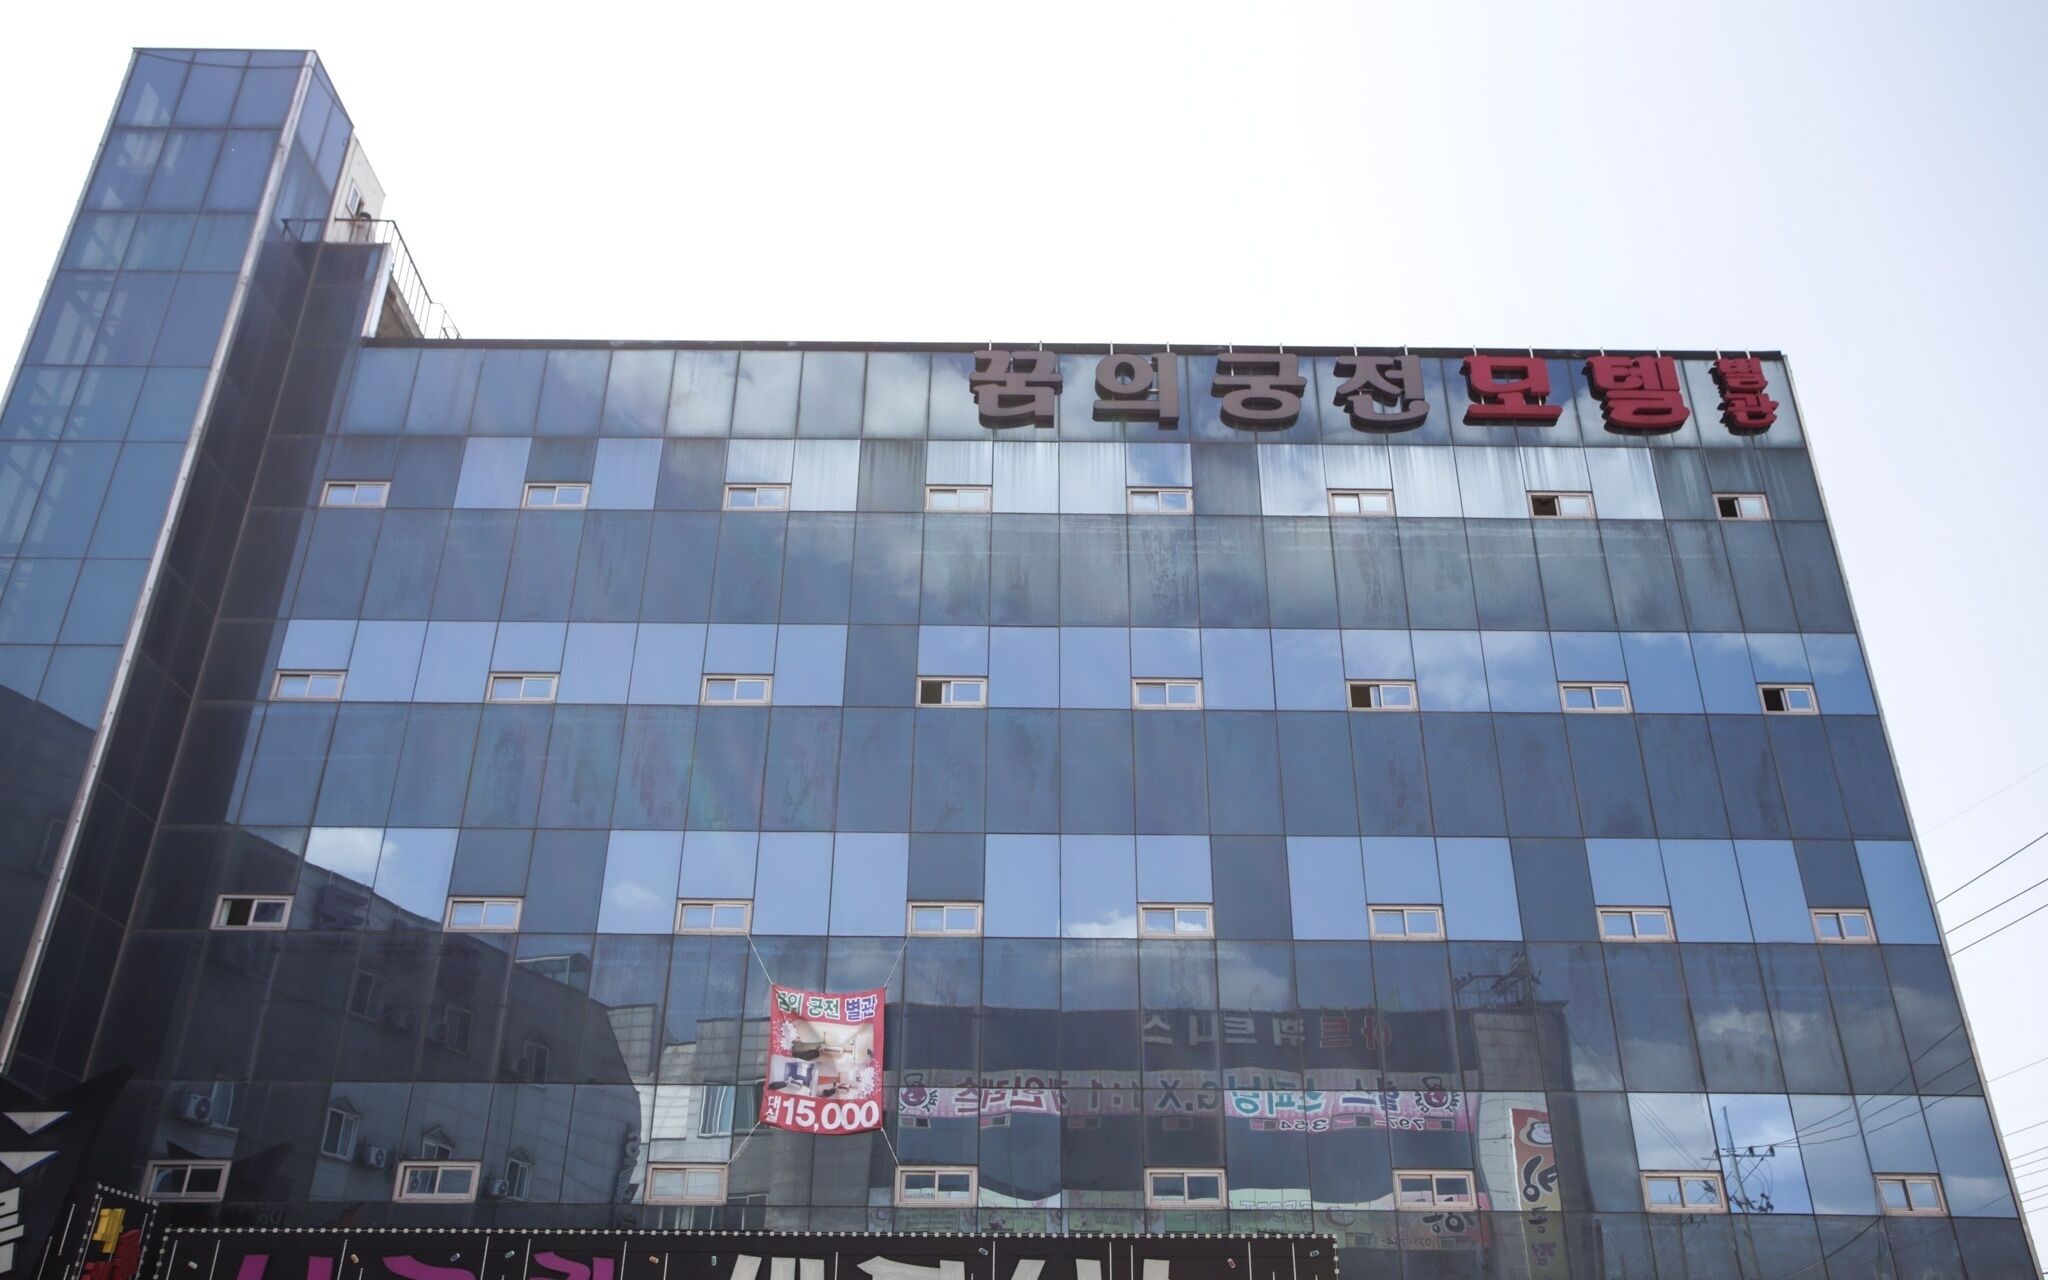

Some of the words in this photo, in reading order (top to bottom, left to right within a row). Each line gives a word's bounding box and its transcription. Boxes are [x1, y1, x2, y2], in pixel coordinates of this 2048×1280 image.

[1461, 354, 1691, 435] 모텔
[807, 995, 841, 1020] 궁전
[845, 994, 878, 1021] 별관
[783, 1100, 880, 1132] 15,000
